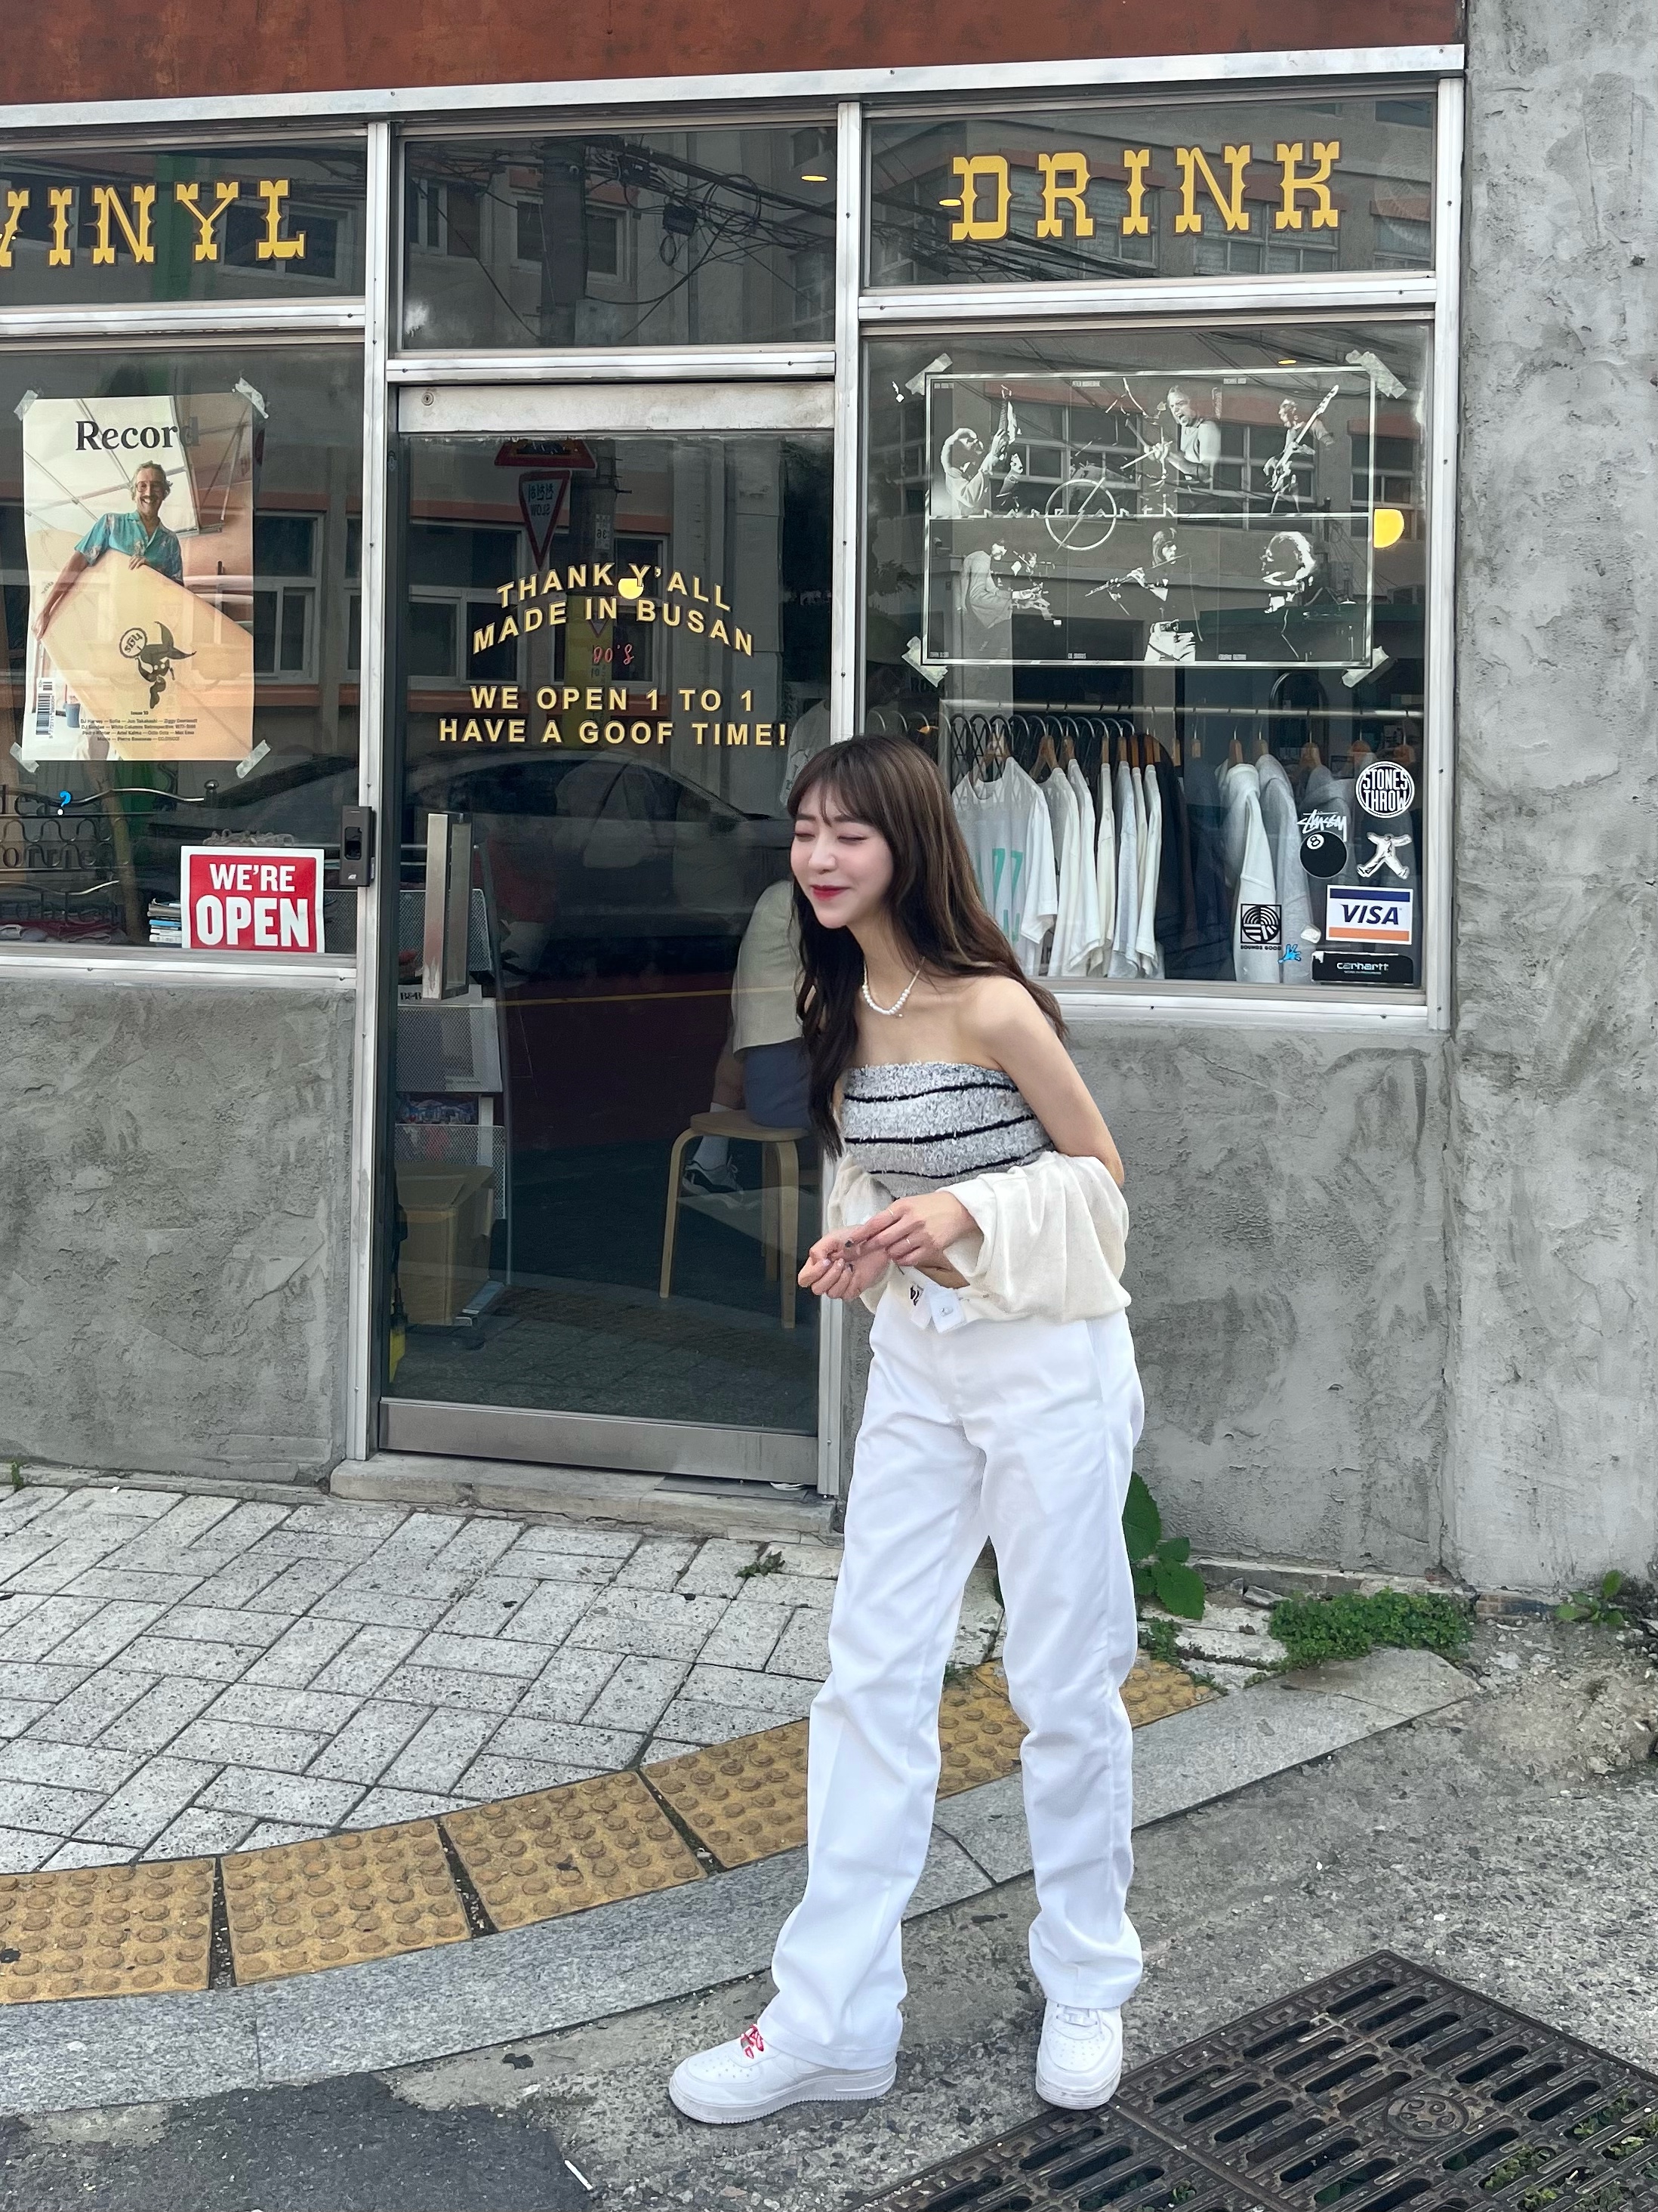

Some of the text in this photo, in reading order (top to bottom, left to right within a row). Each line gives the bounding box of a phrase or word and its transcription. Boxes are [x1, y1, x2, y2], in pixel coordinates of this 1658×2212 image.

[950, 140, 1342, 242] DRINK
[76, 416, 199, 451] Record
[497, 563, 731, 612] THANK Y'ALL
[473, 597, 752, 656] MADE IN BUSAN
[470, 686, 753, 711] WE OPEN 1 TO 1
[439, 719, 787, 746] HAVE A GOOF TIME!
[1362, 769, 1409, 791] STONES
[1363, 789, 1407, 812] THROW
[210, 863, 296, 893] WE'RE
[195, 896, 310, 948] OPEN
[1340, 902, 1399, 925] VISA
[1336, 961, 1389, 971] carhartt
